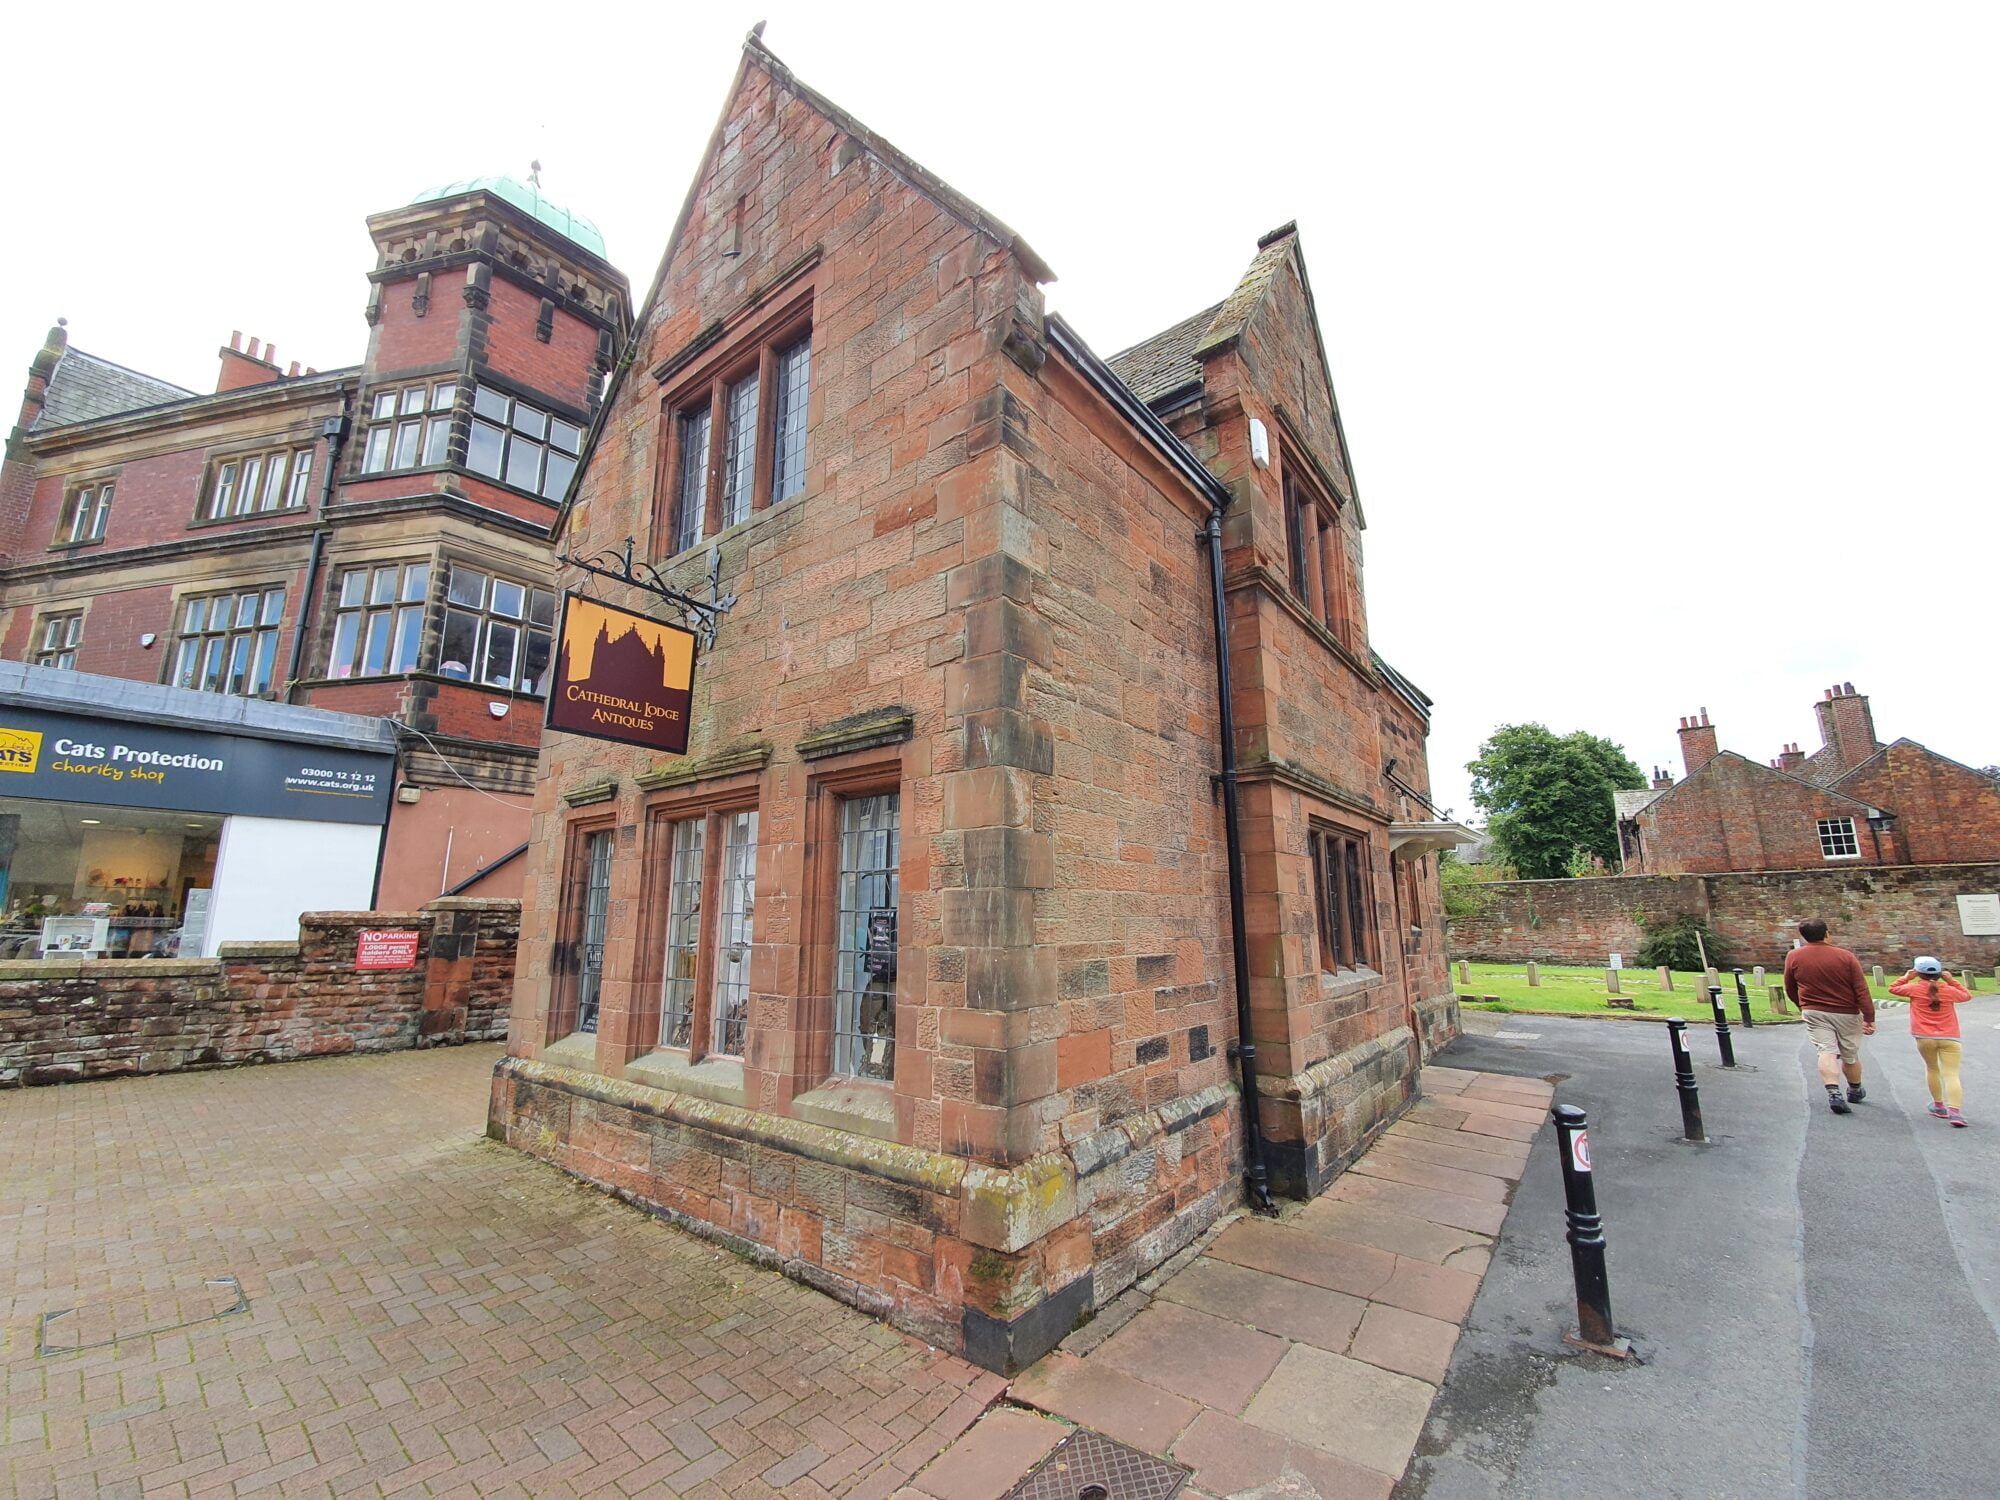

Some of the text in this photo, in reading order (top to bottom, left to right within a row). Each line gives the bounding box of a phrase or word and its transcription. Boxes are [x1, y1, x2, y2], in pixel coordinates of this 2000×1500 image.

[566, 685, 680, 721] CATHEDRAL LODGE
[591, 708, 654, 731] ANTIQUES
[0, 748, 33, 763] ATS
[54, 738, 224, 772] Cats Protection
[51, 758, 166, 784] charity shop
[301, 768, 376, 783] 03000 12 12 12
[285, 777, 374, 791] www.cats.org.uk
[363, 932, 382, 942] NO
